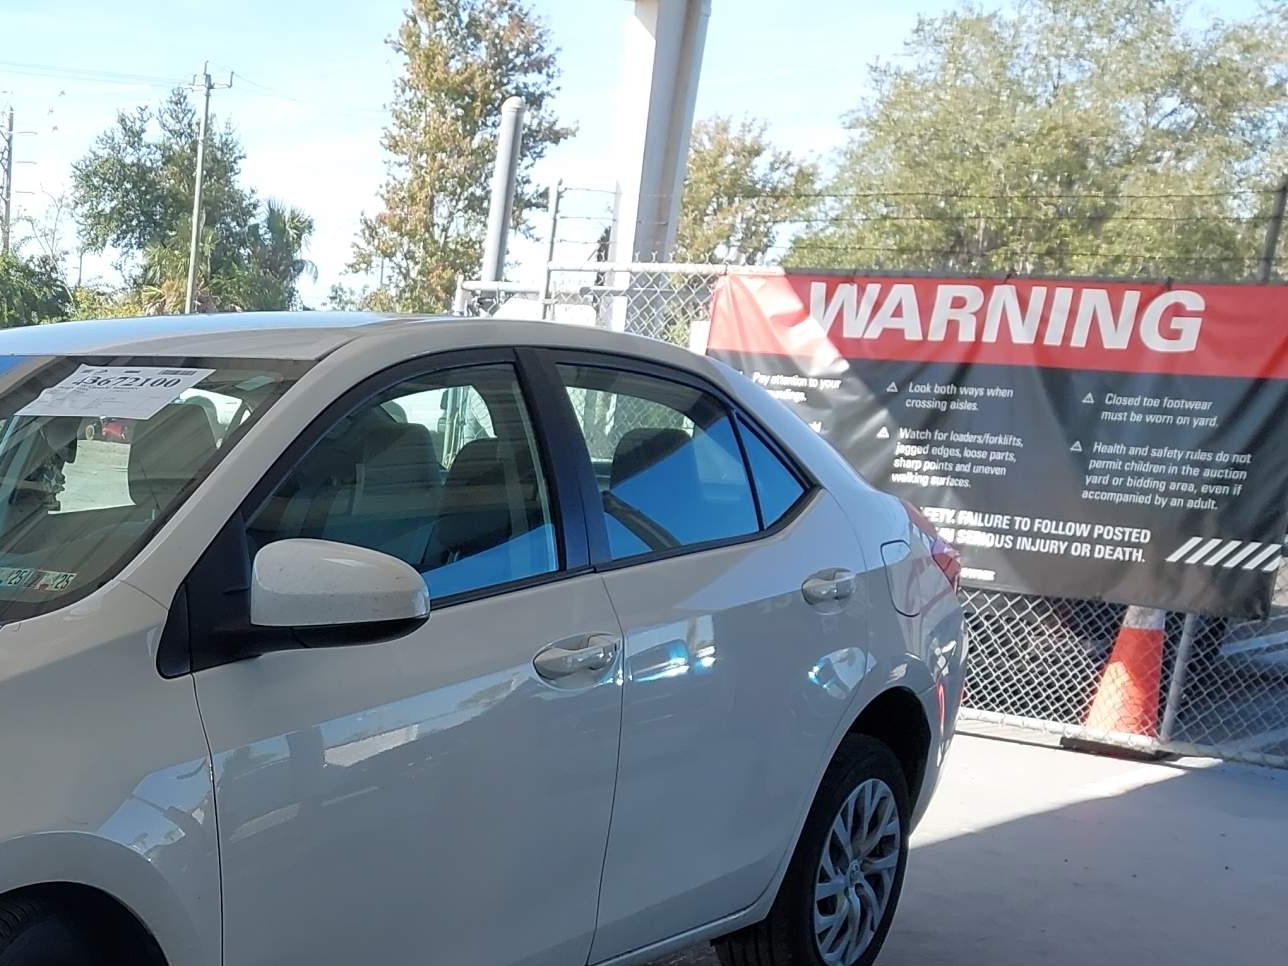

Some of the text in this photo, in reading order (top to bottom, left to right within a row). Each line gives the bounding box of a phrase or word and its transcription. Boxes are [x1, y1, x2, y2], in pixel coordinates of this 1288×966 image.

[810, 281, 1207, 353] WARNING
[71, 376, 181, 388] 43672100
[771, 375, 808, 387] attention
[808, 378, 818, 388] to
[819, 379, 842, 390] your
[909, 383, 1013, 398] Look both ways when
[905, 399, 979, 411] crossing aisles.
[1105, 393, 1213, 410] Closed toe footwear
[1100, 411, 1219, 428] must be worn on yard.
[899, 427, 1024, 448] Watch for loaders/forklifts,
[895, 442, 1016, 462] jagged edges, loose parts,
[1093, 442, 1252, 464] Health and safety rules do not
[893, 457, 1007, 476] sharp points and uneven
[1088, 458, 1247, 480] permit children in the auction
[891, 473, 971, 488] walking surfaces.
[1085, 474, 1243, 496] yard or bidding area, even if
[1081, 489, 1218, 510] accompanied by an adult.
[920, 506, 1151, 544] FETY. FAILURE TO FOLLOW POSTED
[956, 529, 1014, 550] SERIOUS
[1016, 536, 1068, 555] INJURY
[1071, 540, 1092, 556] OR
[1094, 543, 1146, 563] DEATH.
